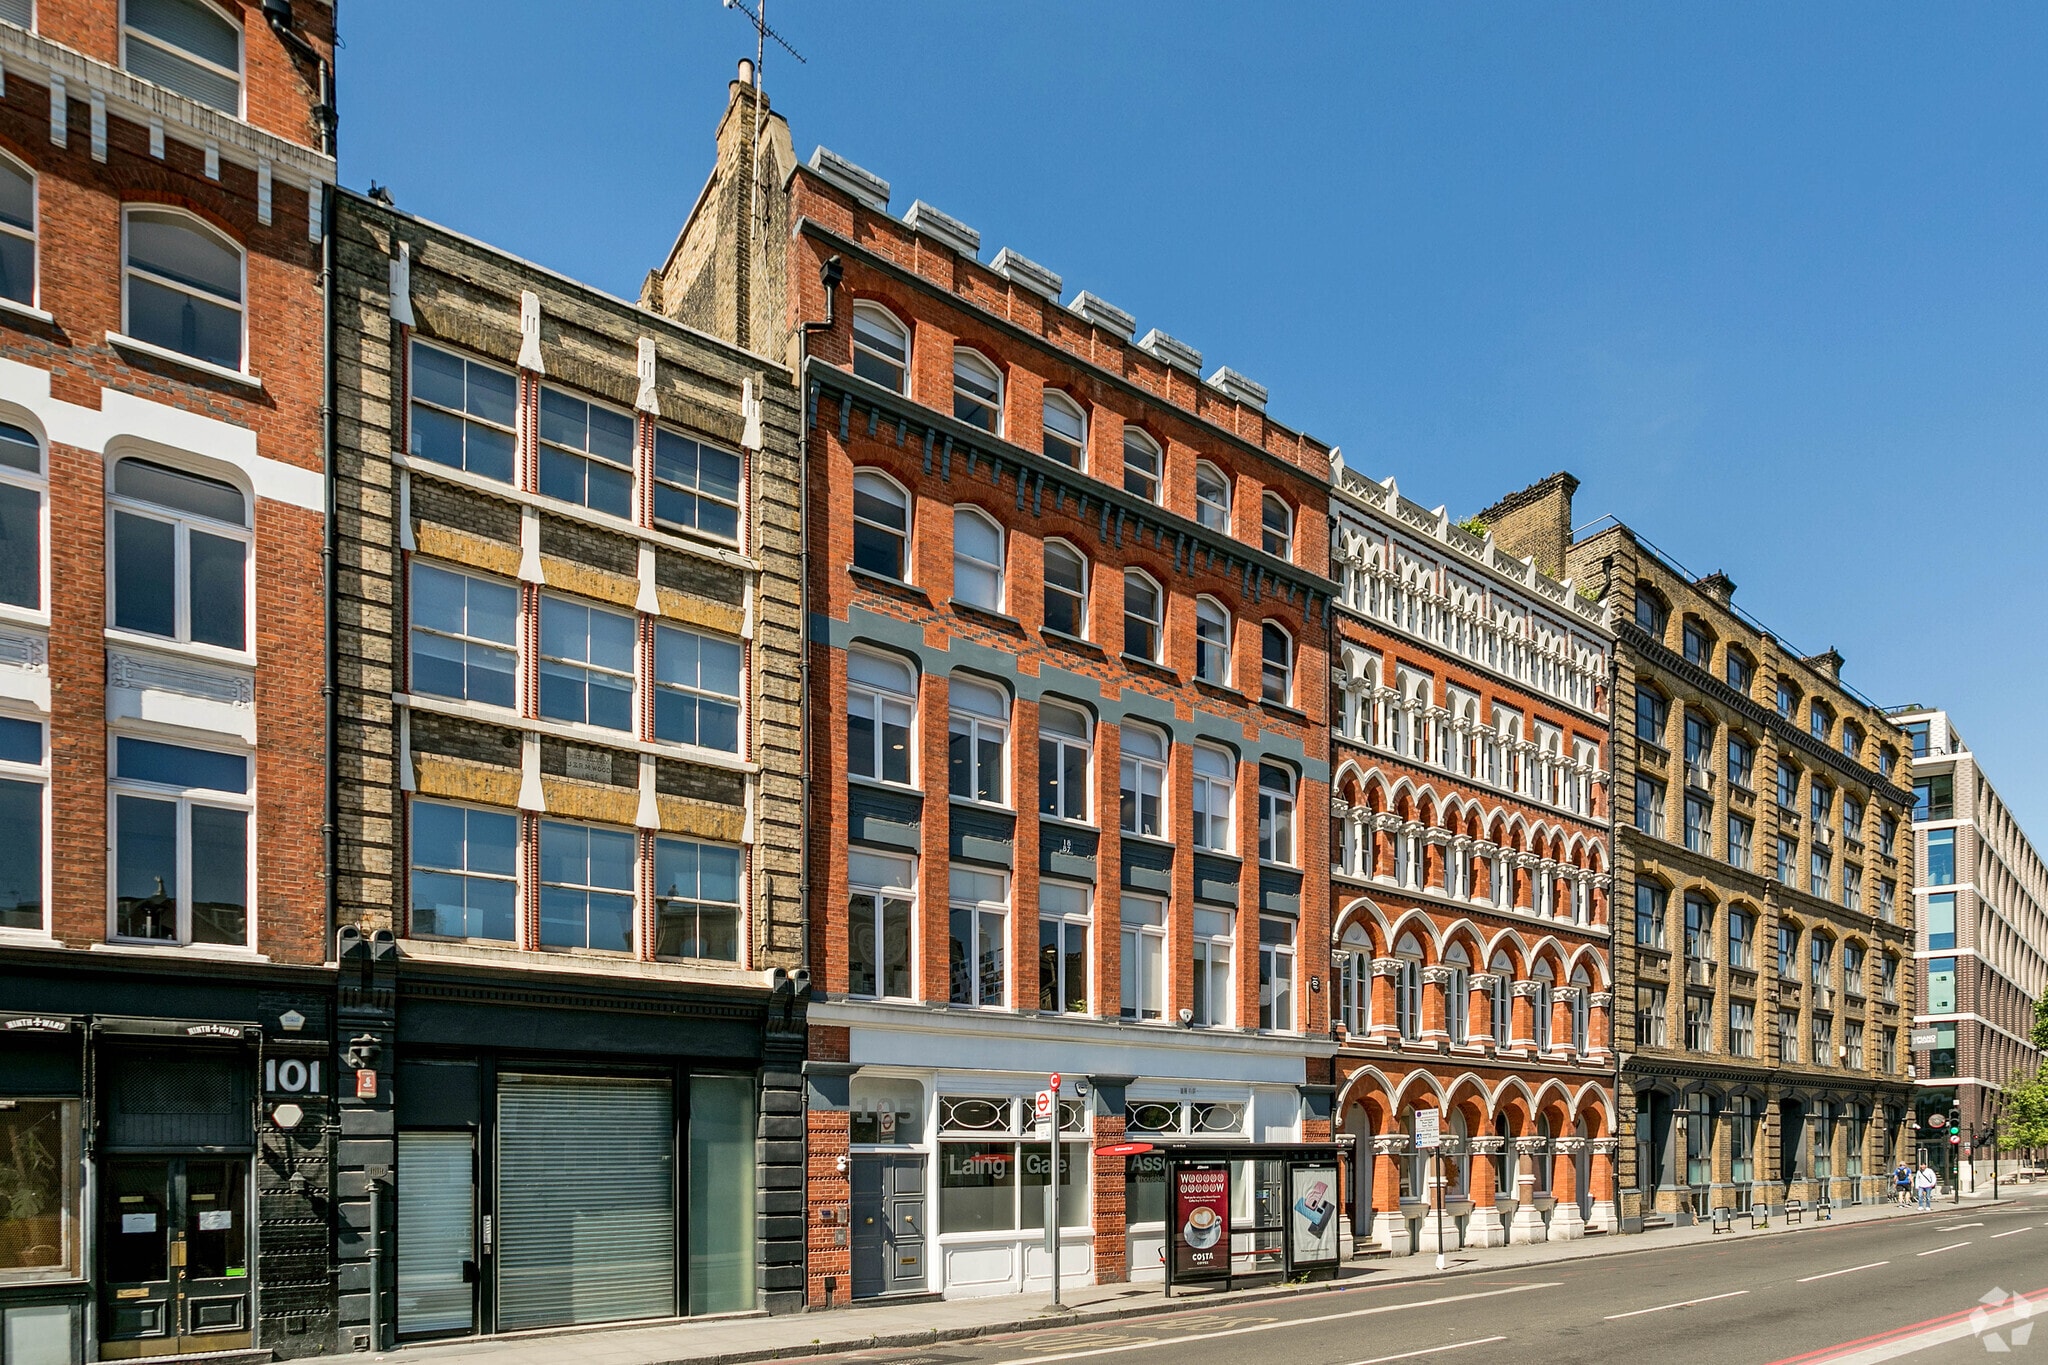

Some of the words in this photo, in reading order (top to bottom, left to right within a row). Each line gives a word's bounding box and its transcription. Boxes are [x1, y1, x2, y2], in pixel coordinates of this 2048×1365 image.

[5, 1018, 33, 1029] NINTH
[41, 1019, 66, 1031] WARD
[186, 1025, 211, 1036] NINTH
[218, 1025, 240, 1037] WARD
[265, 1059, 320, 1093] 101
[1050, 1074, 1058, 1087] C
[856, 1097, 917, 1125] 105
[950, 1151, 1006, 1180] Laing
[1026, 1154, 1067, 1175] Gae
[1130, 1154, 1166, 1172] Ass
[1191, 1252, 1214, 1261] COSTA
